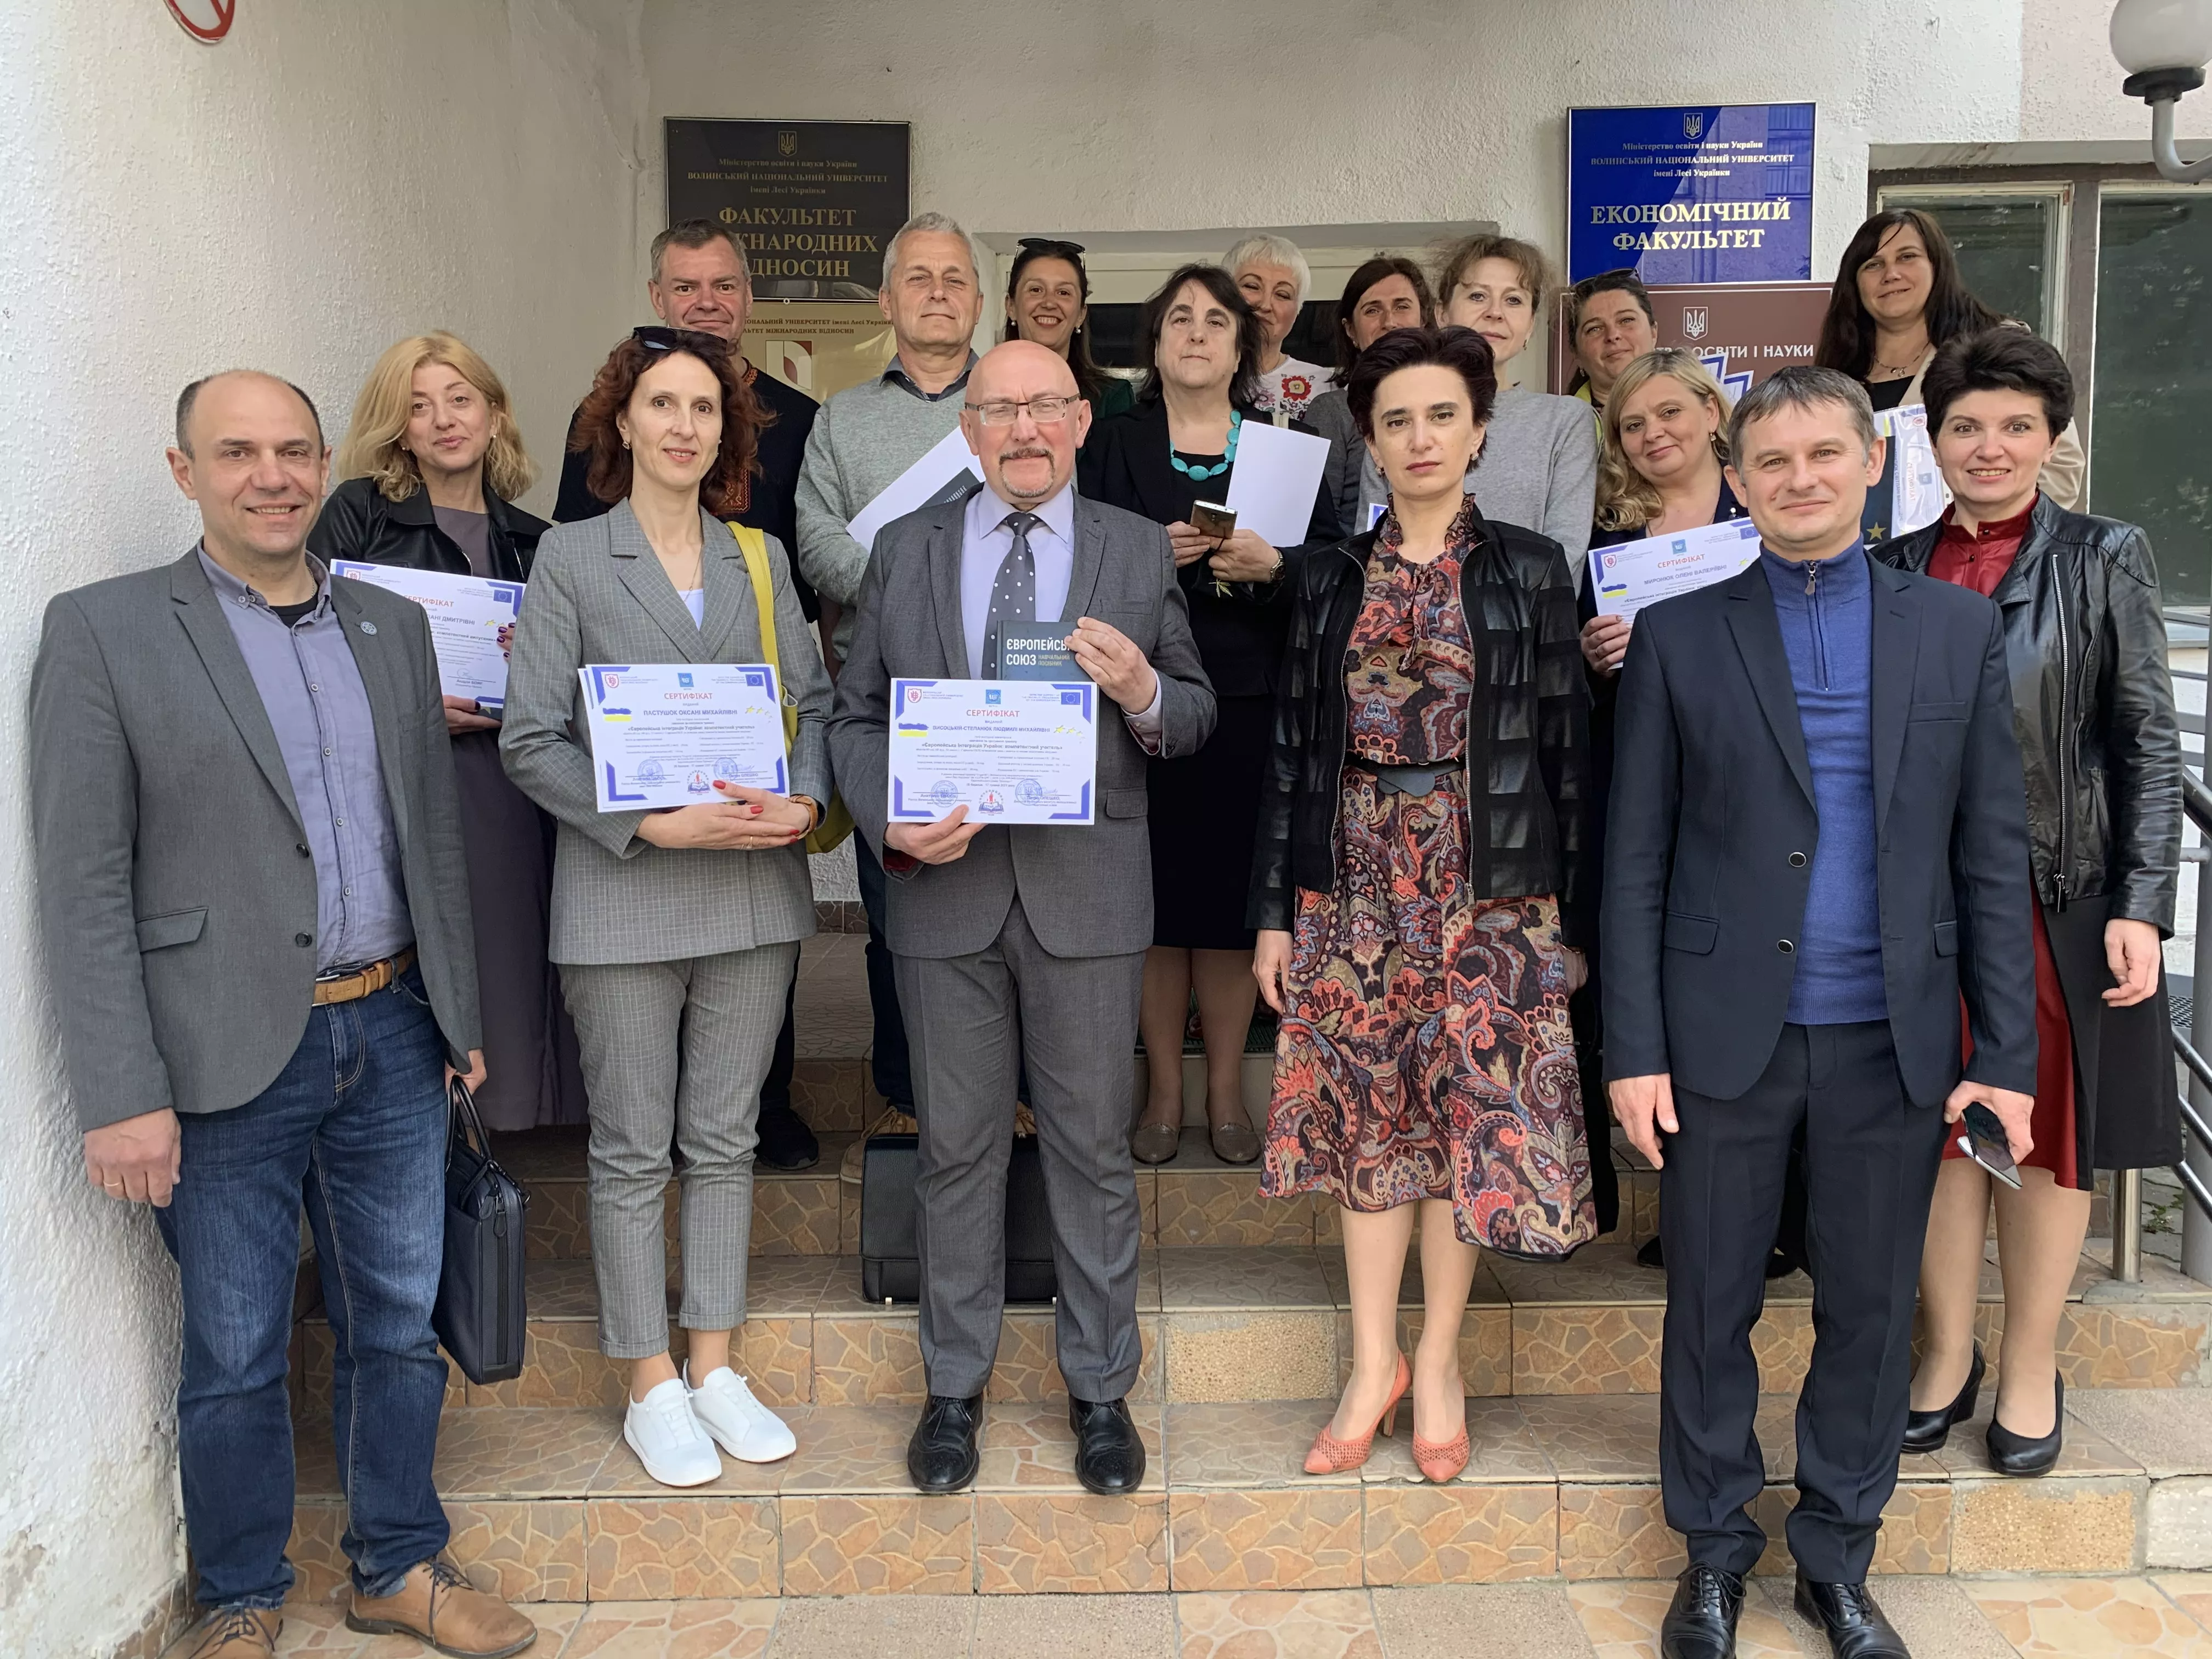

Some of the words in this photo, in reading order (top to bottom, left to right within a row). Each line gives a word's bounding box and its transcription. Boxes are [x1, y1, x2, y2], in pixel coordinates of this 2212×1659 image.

[1622, 142, 1674, 151] Міністерство
[1675, 142, 1700, 150] освіти
[1731, 140, 1763, 150] України
[719, 159, 769, 167] Міністерство
[826, 160, 857, 169] України
[1590, 156, 1653, 165] ВОЛИНСЬКИЙ
[1655, 154, 1729, 165] НАЦІОНАЛЬНИЙ
[1731, 154, 1795, 163] УНІВЕРСИТЕТ
[687, 172, 749, 180] ВОЛИНСЬКИЙ
[751, 173, 824, 181] НАЦІОНАЛЬНИЙ
[826, 174, 888, 182] УНІВЕРСИТЕТ
[1694, 169, 1730, 178] Українки
[790, 187, 826, 195] Українки
[719, 207, 856, 225] ФАКУЛЬТЕТ
[1590, 196, 1791, 224] ЕКОНОМІЧНИЙ
[736, 233, 879, 255] НАРОДНИХ
[1613, 229, 1765, 250] ФАКУЛЬТЕТ
[750, 258, 850, 279] ДНОСИН
[1695, 346, 1747, 358] ОСВІТИ
[1753, 346, 1757, 357] І
[1764, 345, 1814, 357] НАУКИ
[1657, 554, 1705, 568] СЕРТИФІКАТ
[1644, 575, 1674, 585] МИРОНЮК
[1694, 565, 1727, 575] ВАЛЕРІЇВНІ
[442, 616, 475, 625] ДМИТРІВНІ
[1007, 637, 1069, 651] ЄВРОПЕЙСЬ
[1006, 654, 1036, 665] СОЮЗ
